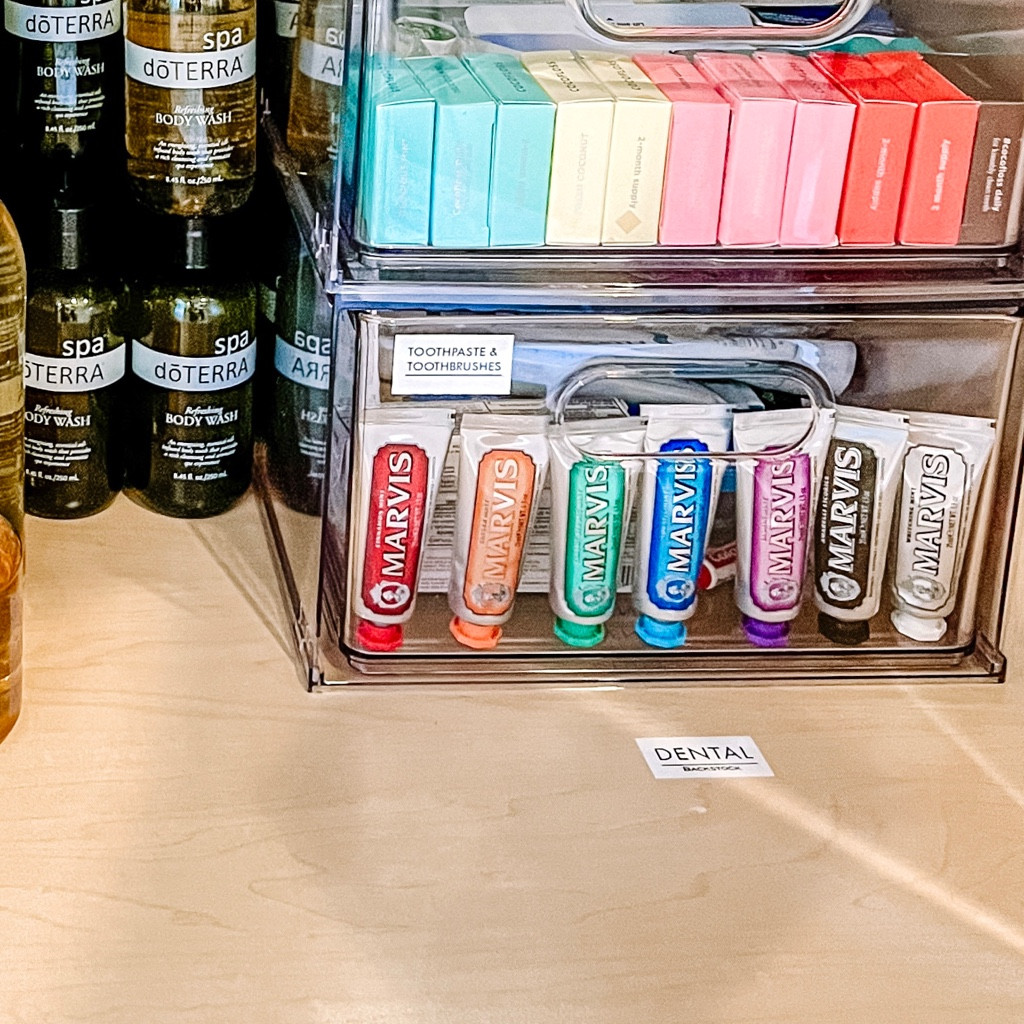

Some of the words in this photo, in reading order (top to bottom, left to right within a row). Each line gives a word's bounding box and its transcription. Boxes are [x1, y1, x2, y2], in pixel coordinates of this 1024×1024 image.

[202, 25, 243, 54] spa
[74, 61, 105, 77] WASH
[155, 112, 193, 127] BODY
[195, 111, 232, 126] WASH
[628, 178, 641, 209] supply
[991, 189, 1005, 212] daily
[61, 336, 104, 359] spa
[214, 329, 249, 356] spa
[408, 346, 486, 357] TOOTHPASTE
[489, 346, 498, 357] &
[24, 363, 105, 384] ōTERRA
[407, 361, 502, 372] TOOTHBRUSHES
[24, 411, 52, 426] ODY
[53, 415, 92, 428] WASH
[165, 413, 203, 427] BODY
[204, 409, 239, 426] WASH
[381, 450, 413, 577] MARVIS
[482, 456, 519, 580] MARVIS
[666, 447, 697, 573] MARVIS
[767, 459, 796, 576] MARVIS
[827, 446, 863, 573] MARVIS
[912, 453, 950, 577] MARVIS
[582, 464, 613, 583] MARVIS
[654, 746, 754, 761] DENTAL
